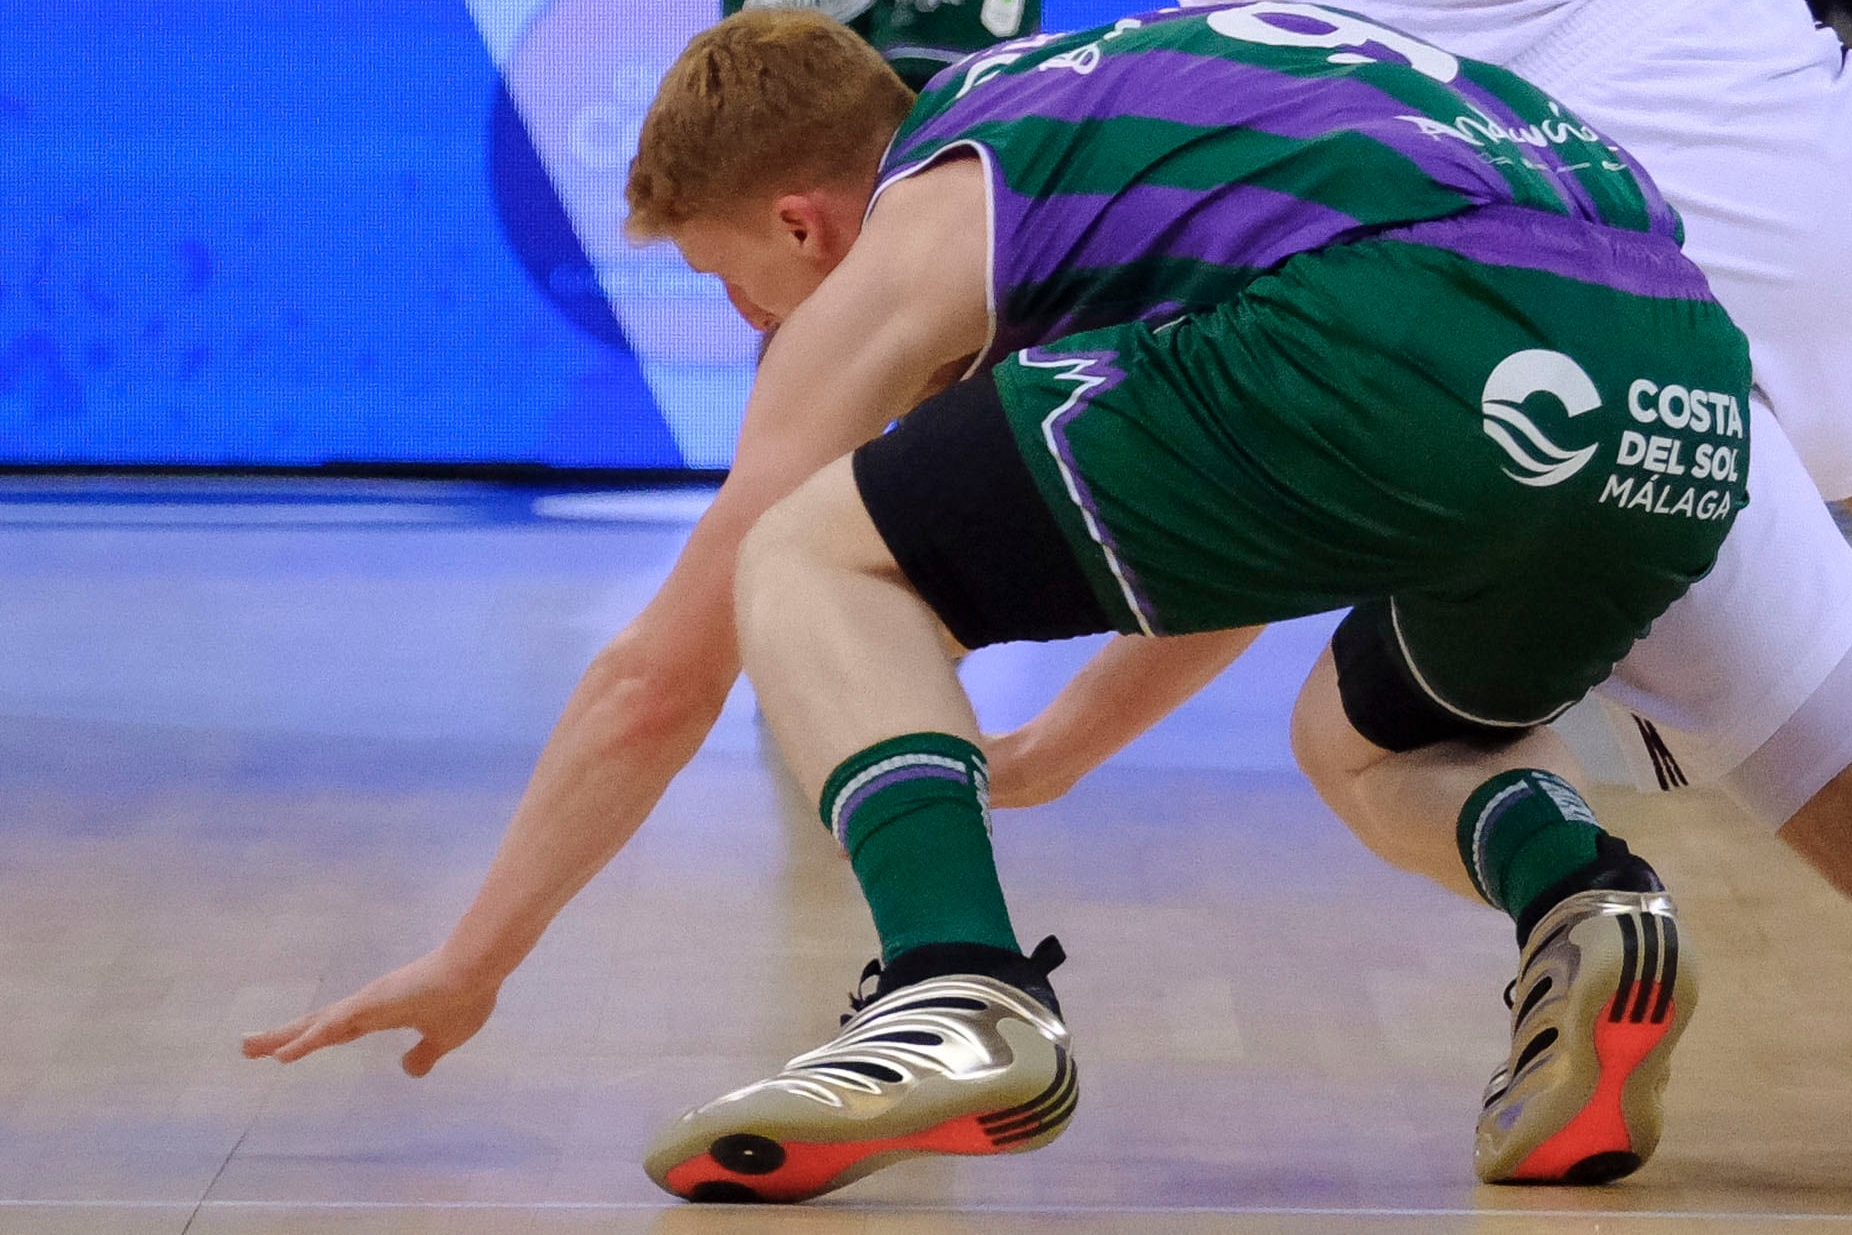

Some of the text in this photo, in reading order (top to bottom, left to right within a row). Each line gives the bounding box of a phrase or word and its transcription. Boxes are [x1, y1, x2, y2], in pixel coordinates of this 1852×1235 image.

[1628, 378, 1744, 439] COSTA
[1616, 430, 1739, 483] DEL SOL
[1598, 474, 1732, 521] MÁLAGA
